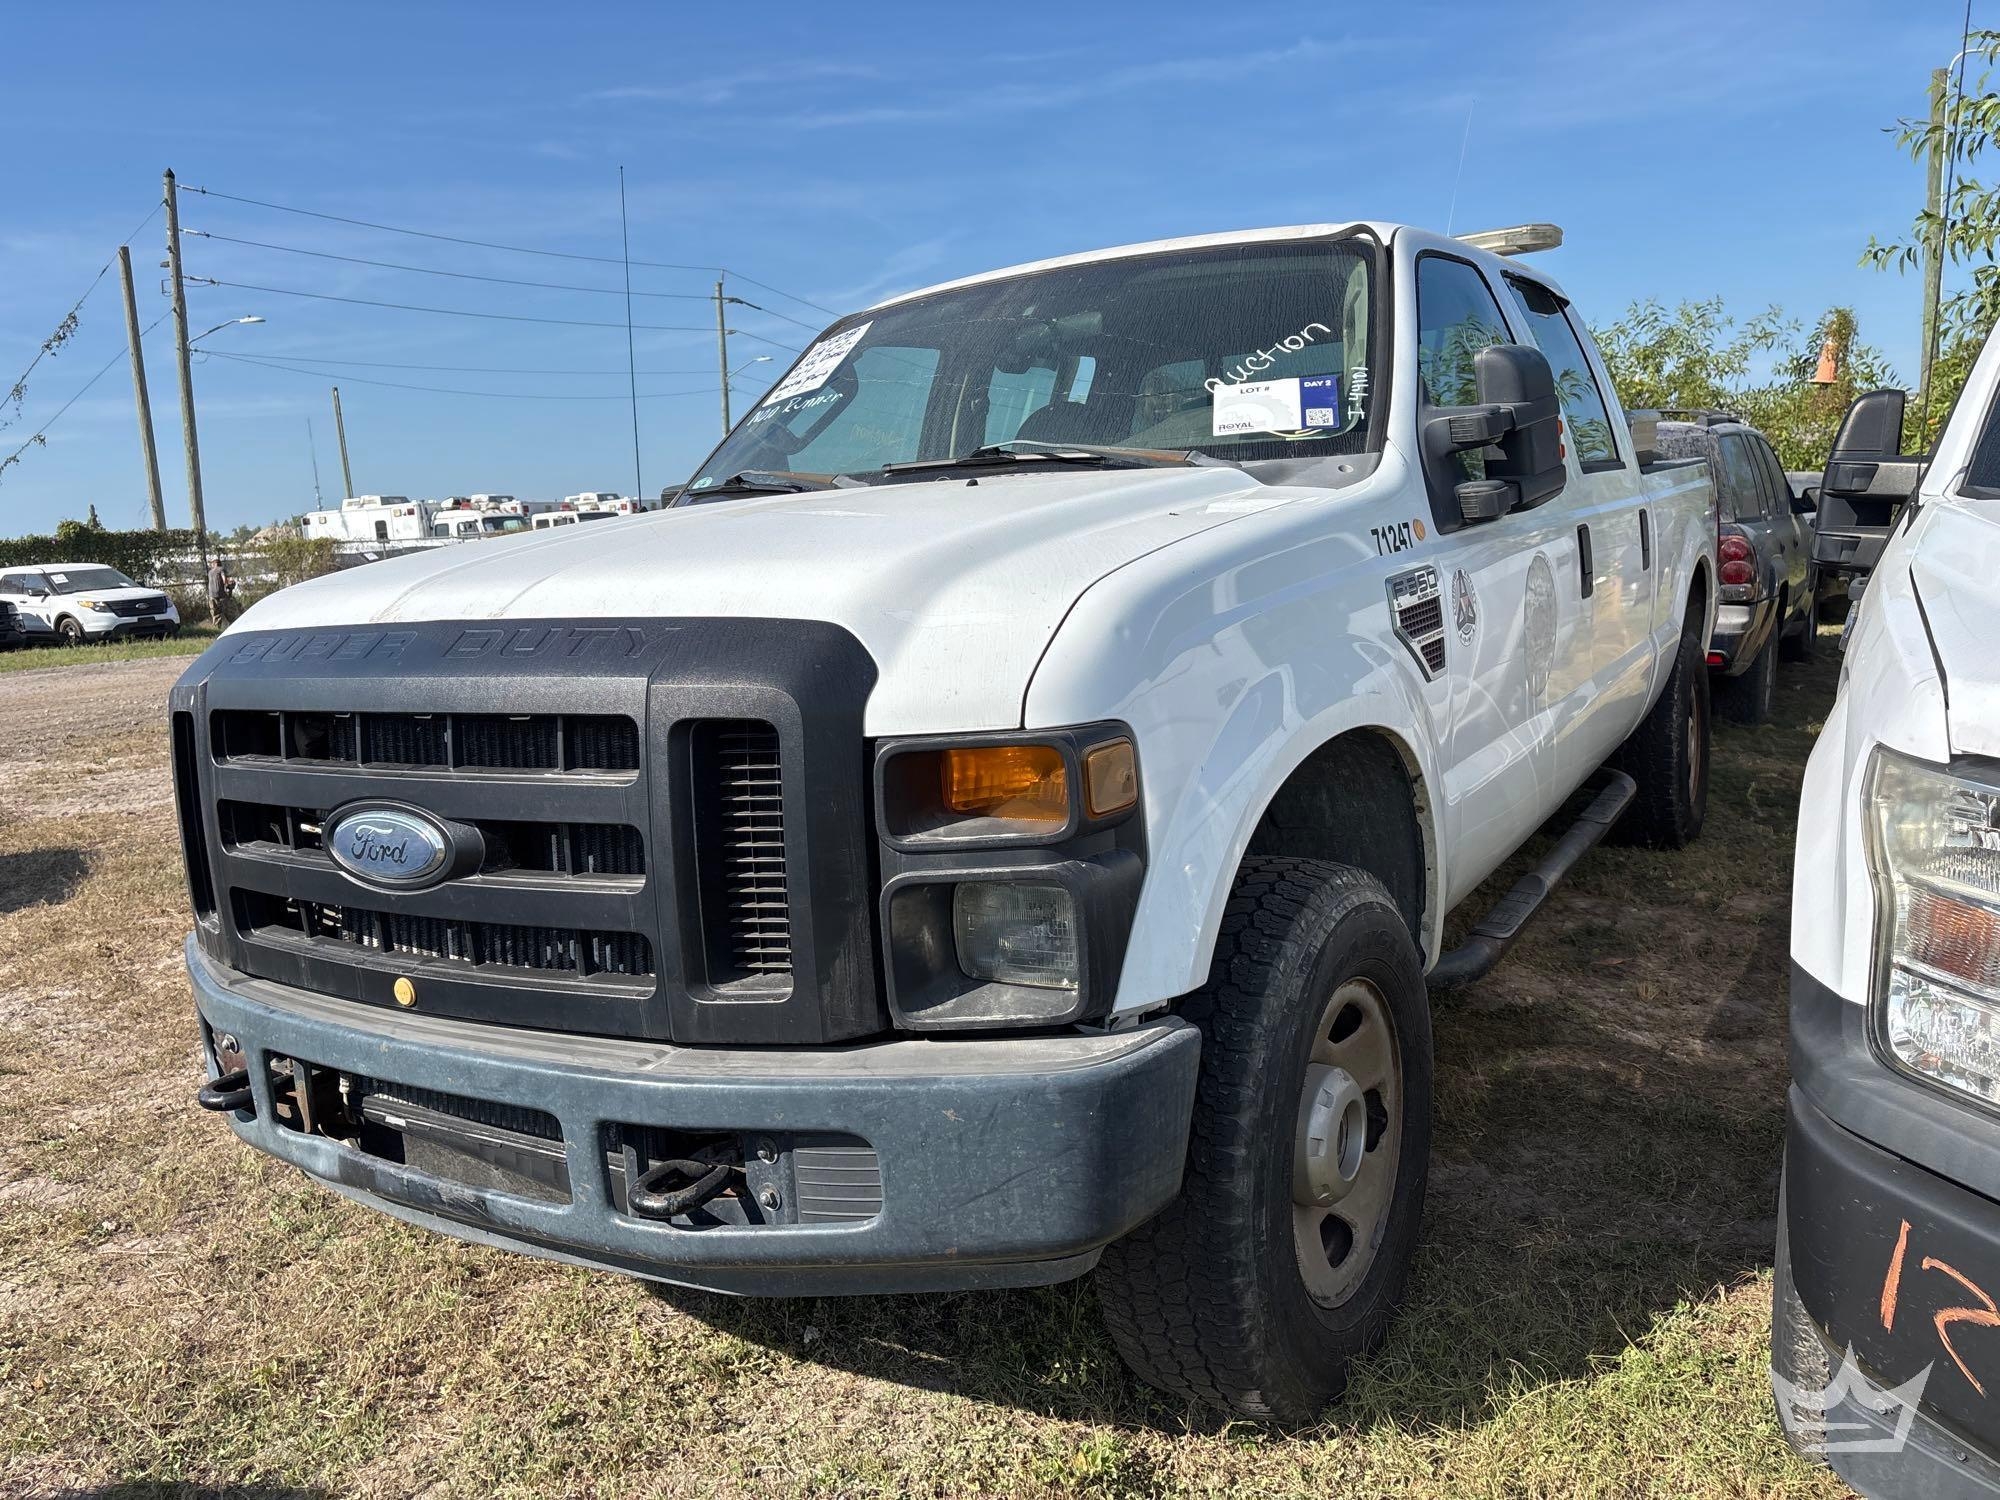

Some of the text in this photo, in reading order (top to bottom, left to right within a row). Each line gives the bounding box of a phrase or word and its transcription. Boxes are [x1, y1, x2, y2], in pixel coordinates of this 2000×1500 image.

[1239, 386, 1261, 394] LOT
[1218, 421, 1254, 431] ROYAL
[1370, 522, 1414, 556] 71247
[1393, 569, 1438, 601] F-350
[229, 627, 684, 664] SUPER DUTY
[351, 824, 409, 865] Ford
